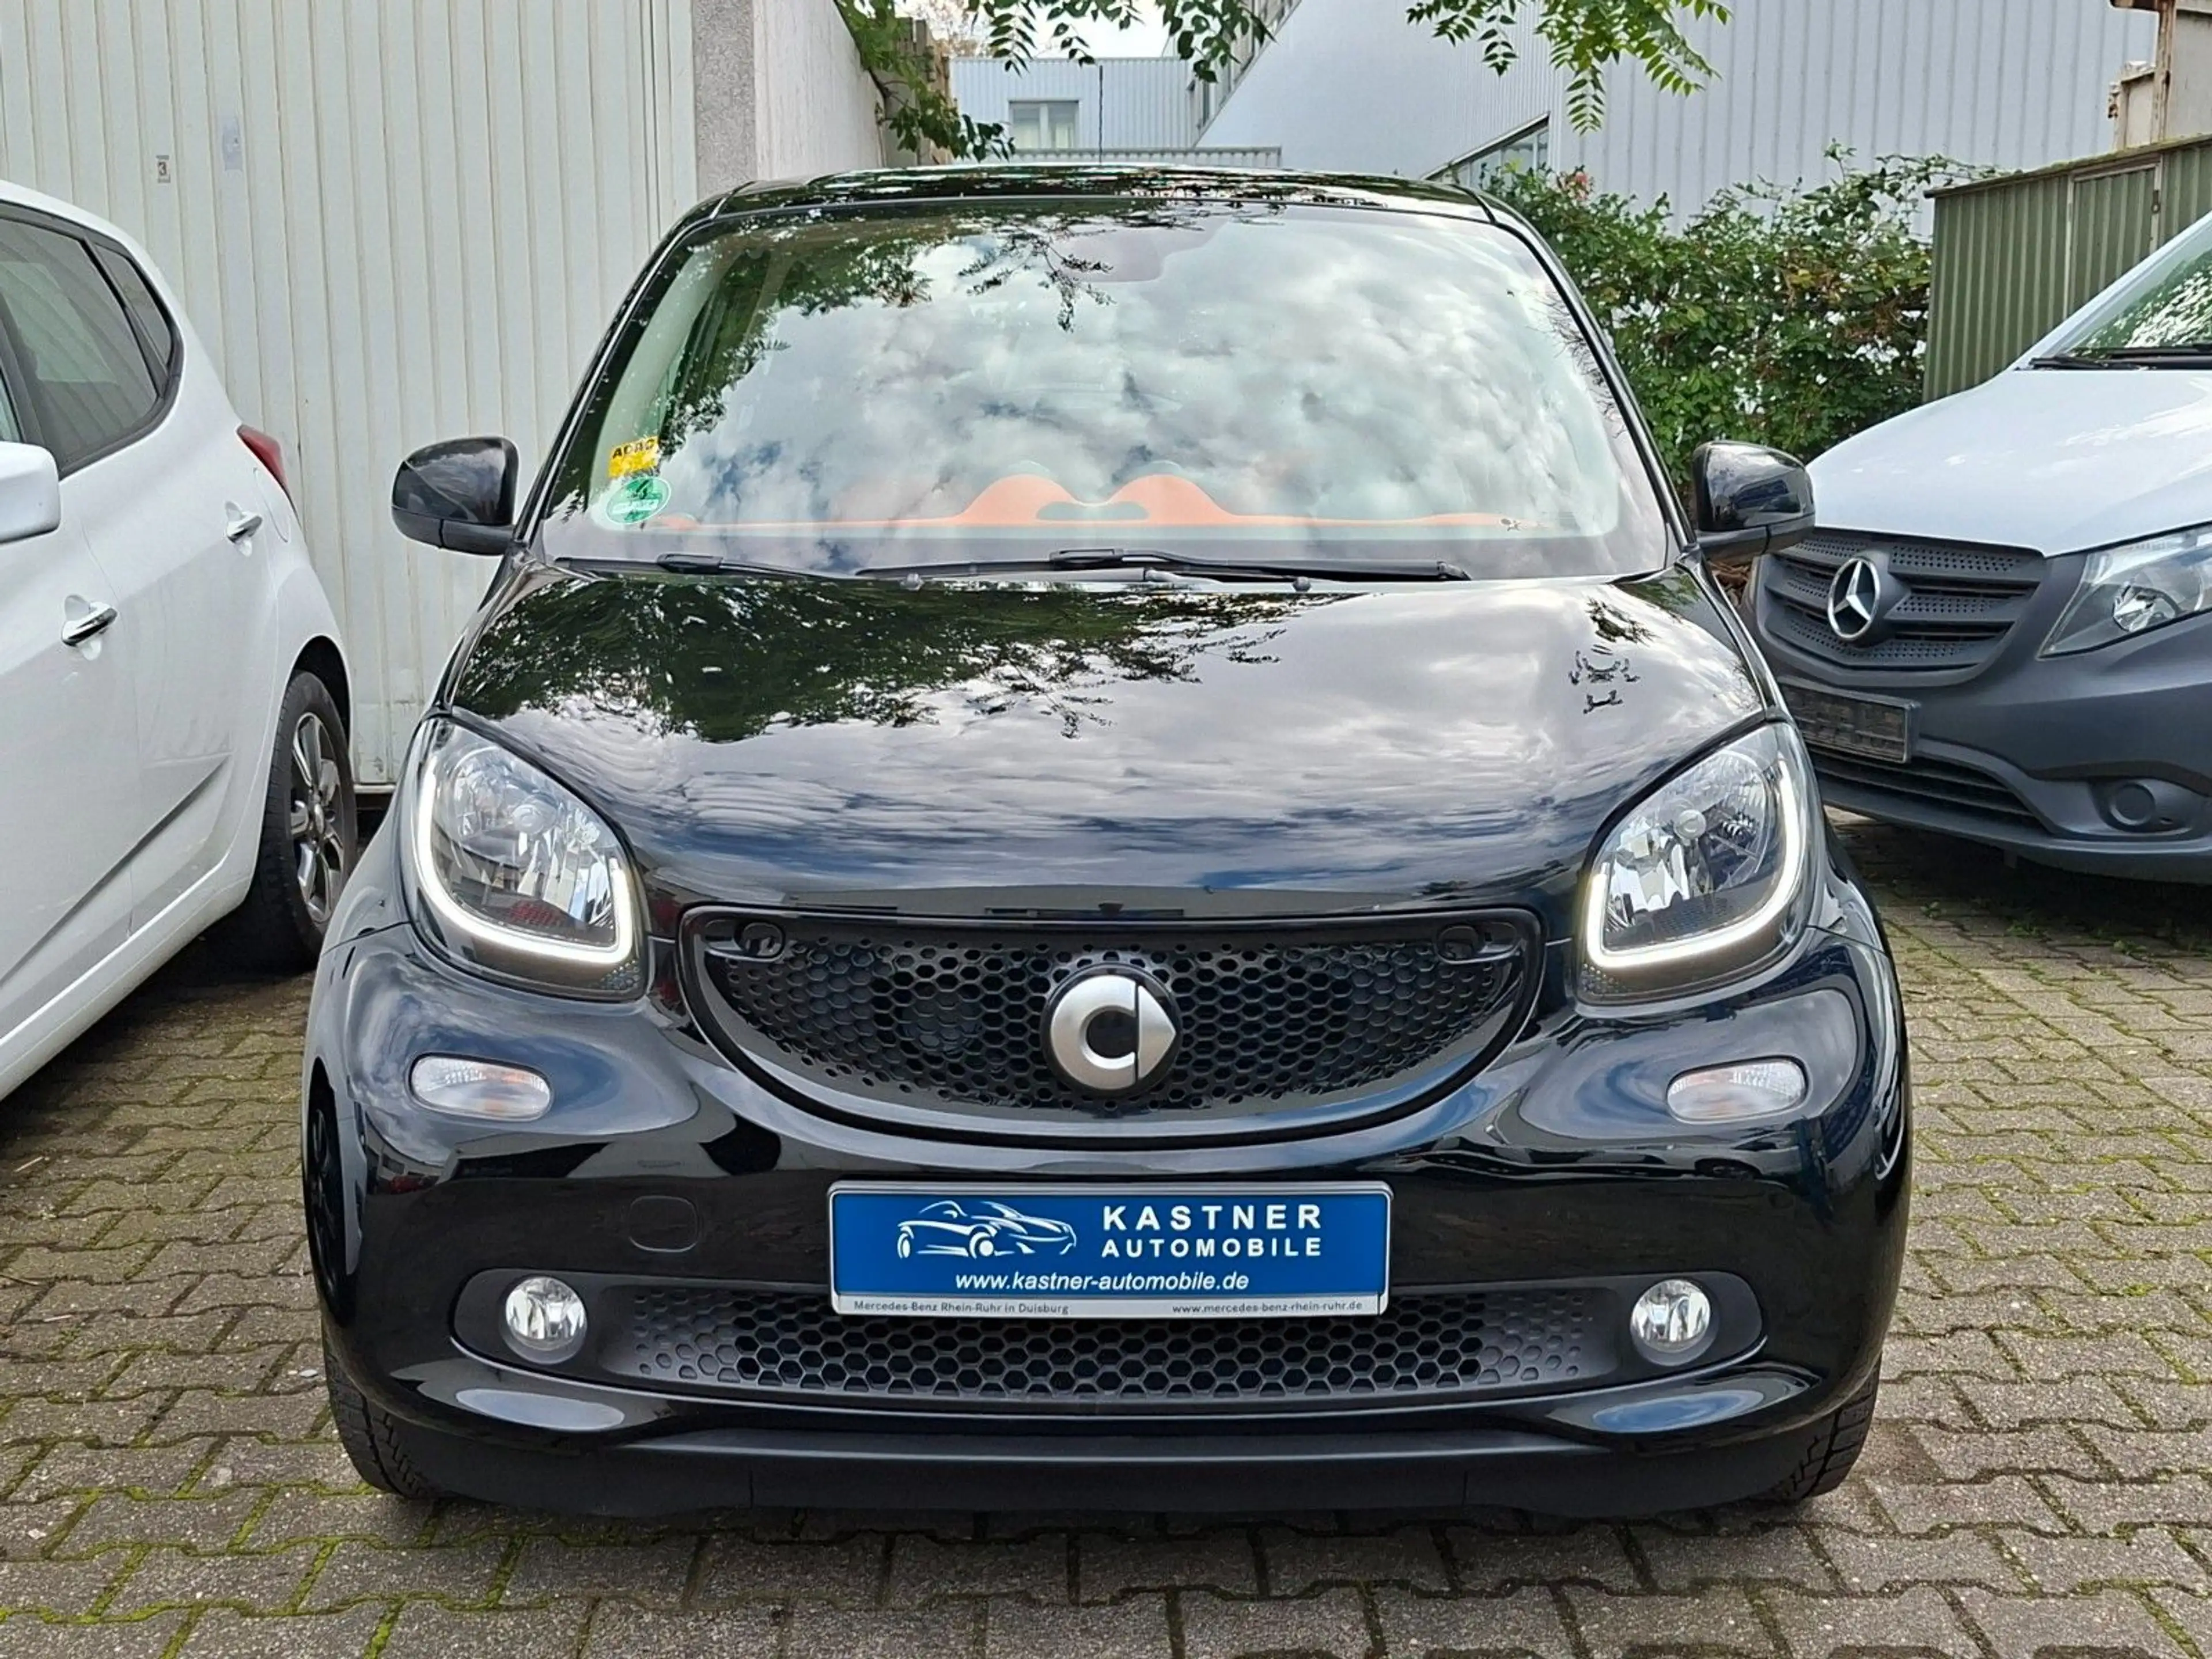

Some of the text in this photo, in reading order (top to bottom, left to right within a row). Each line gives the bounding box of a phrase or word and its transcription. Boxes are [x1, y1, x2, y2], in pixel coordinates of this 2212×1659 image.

[158, 161, 167, 176] 3
[1103, 1204, 1321, 1230] KASTNER
[1101, 1237, 1321, 1258] AUTOMOBILE
[955, 1271, 1249, 1291] www.kastner-automobile.de
[853, 1300, 1069, 1315] Mercedes-Benz Rhein-Ruhr in Duisburg
[1172, 1301, 1363, 1314] www.mercedes-benz-rhein-ruhr.de
